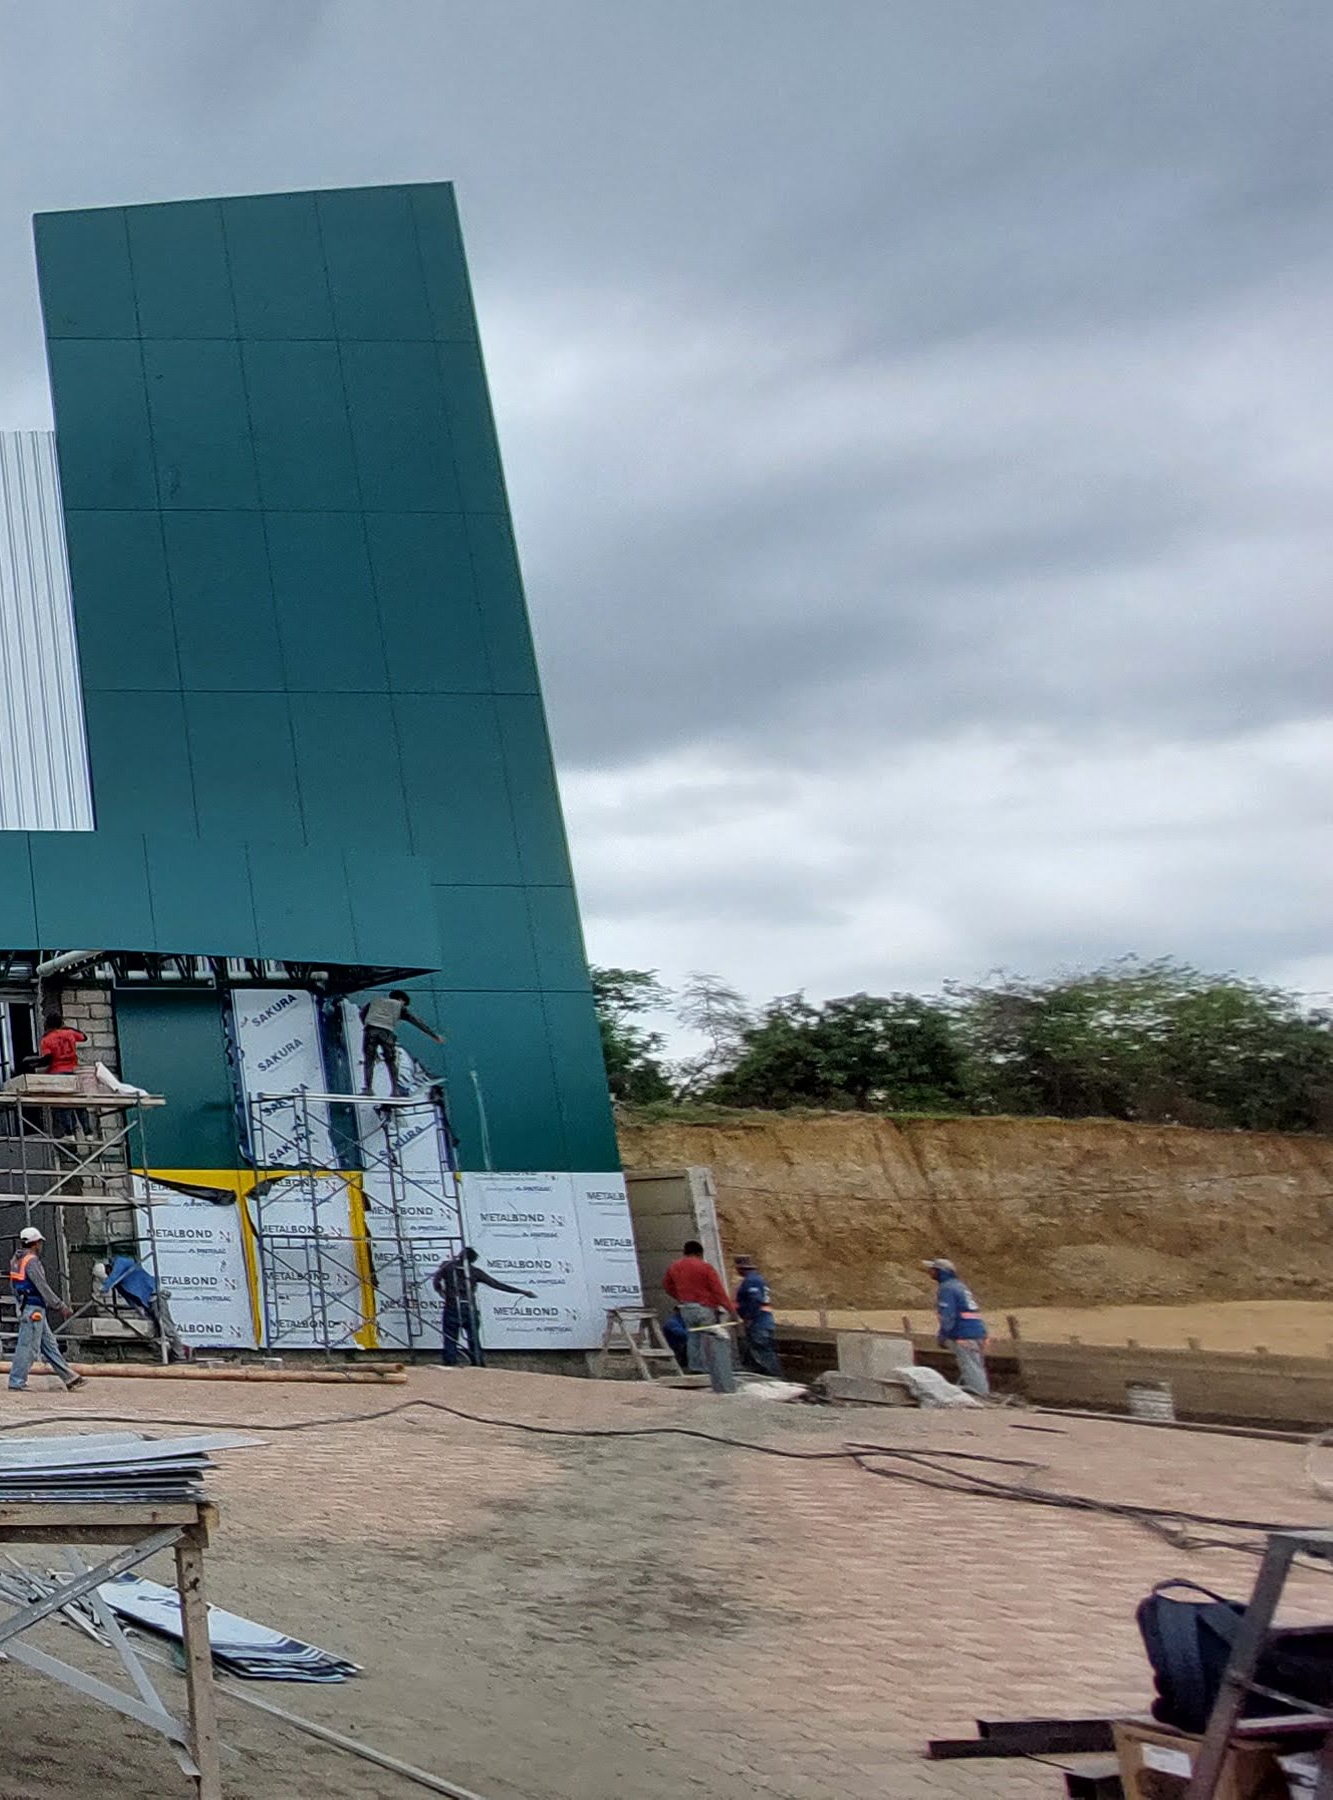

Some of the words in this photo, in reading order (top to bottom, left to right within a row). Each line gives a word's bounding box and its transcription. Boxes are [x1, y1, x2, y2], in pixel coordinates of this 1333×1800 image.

[251, 993, 297, 1027] SAKURA
[258, 1038, 303, 1072] SAKURA
[480, 1213, 545, 1222] METALBOND
[487, 1260, 552, 1268] METALBOND
[161, 1276, 218, 1285] ETALBOND
[493, 1307, 558, 1316] METALBOND
[176, 1324, 223, 1333] ALBOND
